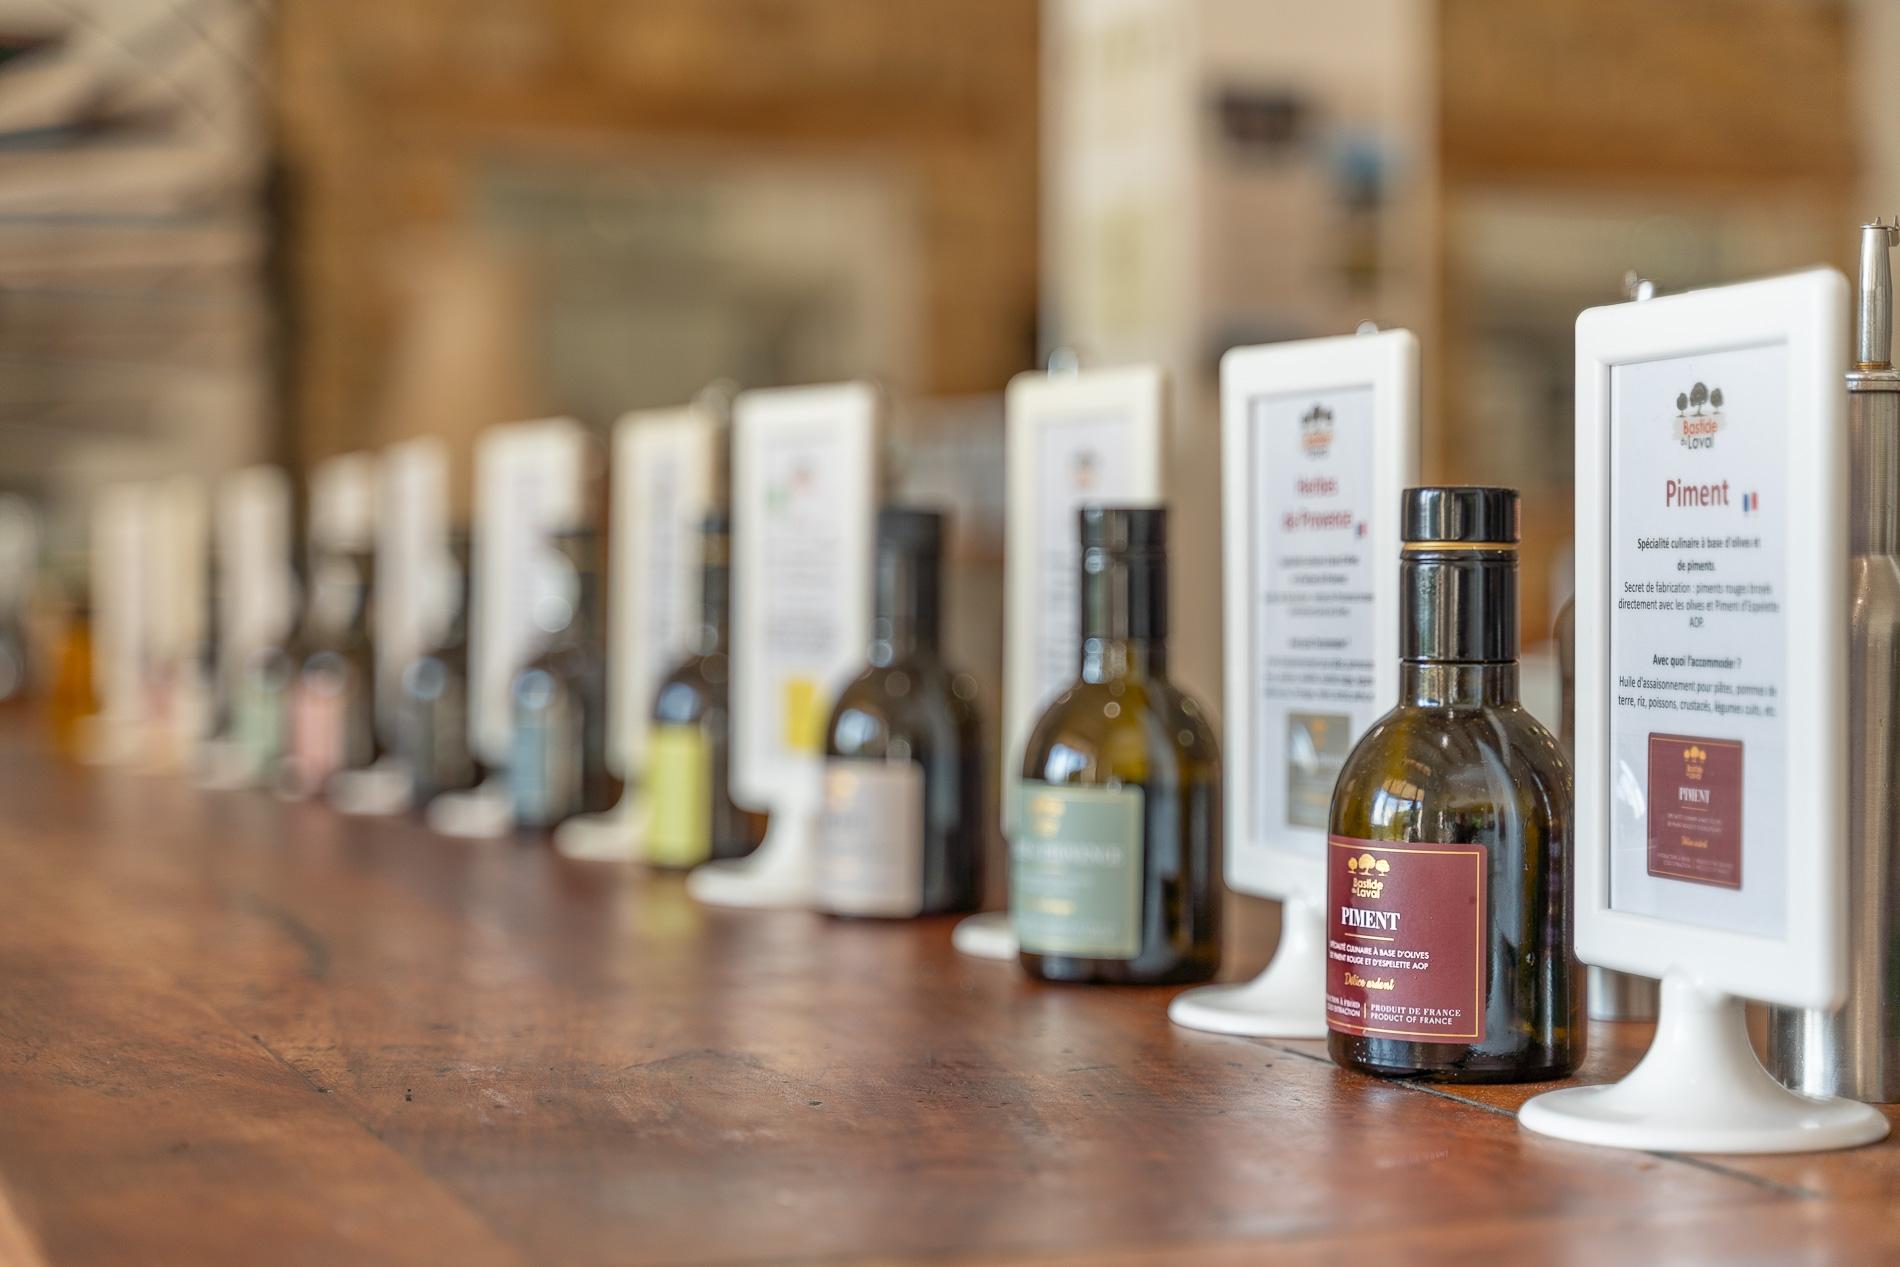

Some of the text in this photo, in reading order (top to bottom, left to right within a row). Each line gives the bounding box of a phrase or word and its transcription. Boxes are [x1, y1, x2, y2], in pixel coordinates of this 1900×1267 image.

[1683, 418, 1717, 435] Bastide
[1688, 434, 1713, 449] Laval
[1666, 478, 1729, 507] Piment
[1637, 537, 1669, 551] Spécialité
[1671, 537, 1699, 549] culinaire
[1701, 537, 1706, 549] à
[1707, 537, 1723, 548] base
[1677, 560, 1686, 571] de
[1624, 581, 1644, 593] Secret
[1645, 582, 1654, 593] de
[1655, 581, 1691, 594] fabrication
[1618, 598, 1658, 610] directement
[1658, 601, 1674, 610] avec
[1675, 599, 1684, 611] les
[1686, 599, 1704, 611] olives
[1706, 601, 1714, 611] et
[1653, 654, 1669, 666] Avec
[1671, 655, 1686, 668] quoi
[1619, 676, 1635, 688] Huile
[1637, 676, 1695, 691] d'assaisonnement
[1697, 683, 1713, 696] pour
[1618, 695, 1635, 708] terre,
[1648, 697, 1678, 711] poissons,
[1678, 786, 1711, 804] PIMENT
[1353, 877, 1384, 890] Bastide
[1357, 887, 1380, 899] Laval
[1341, 906, 1400, 930] PIMENT
[1346, 944, 1372, 955] CULINAIRE
[1373, 947, 1378, 956] À
[1380, 948, 1396, 957] BASE
[1397, 950, 1430, 959] D'OLIVES
[1346, 954, 1364, 964] ROUGE
[1365, 957, 1371, 966] ET
[1372, 958, 1410, 969] D'ESPELETTE
[1412, 962, 1429, 970] AOP
[1366, 977, 1395, 991] ardent
[1370, 1003, 1461, 1017] PRODUIT DE FRANCE
[1370, 1012, 1453, 1025] PRODUCT OF FRANCE
